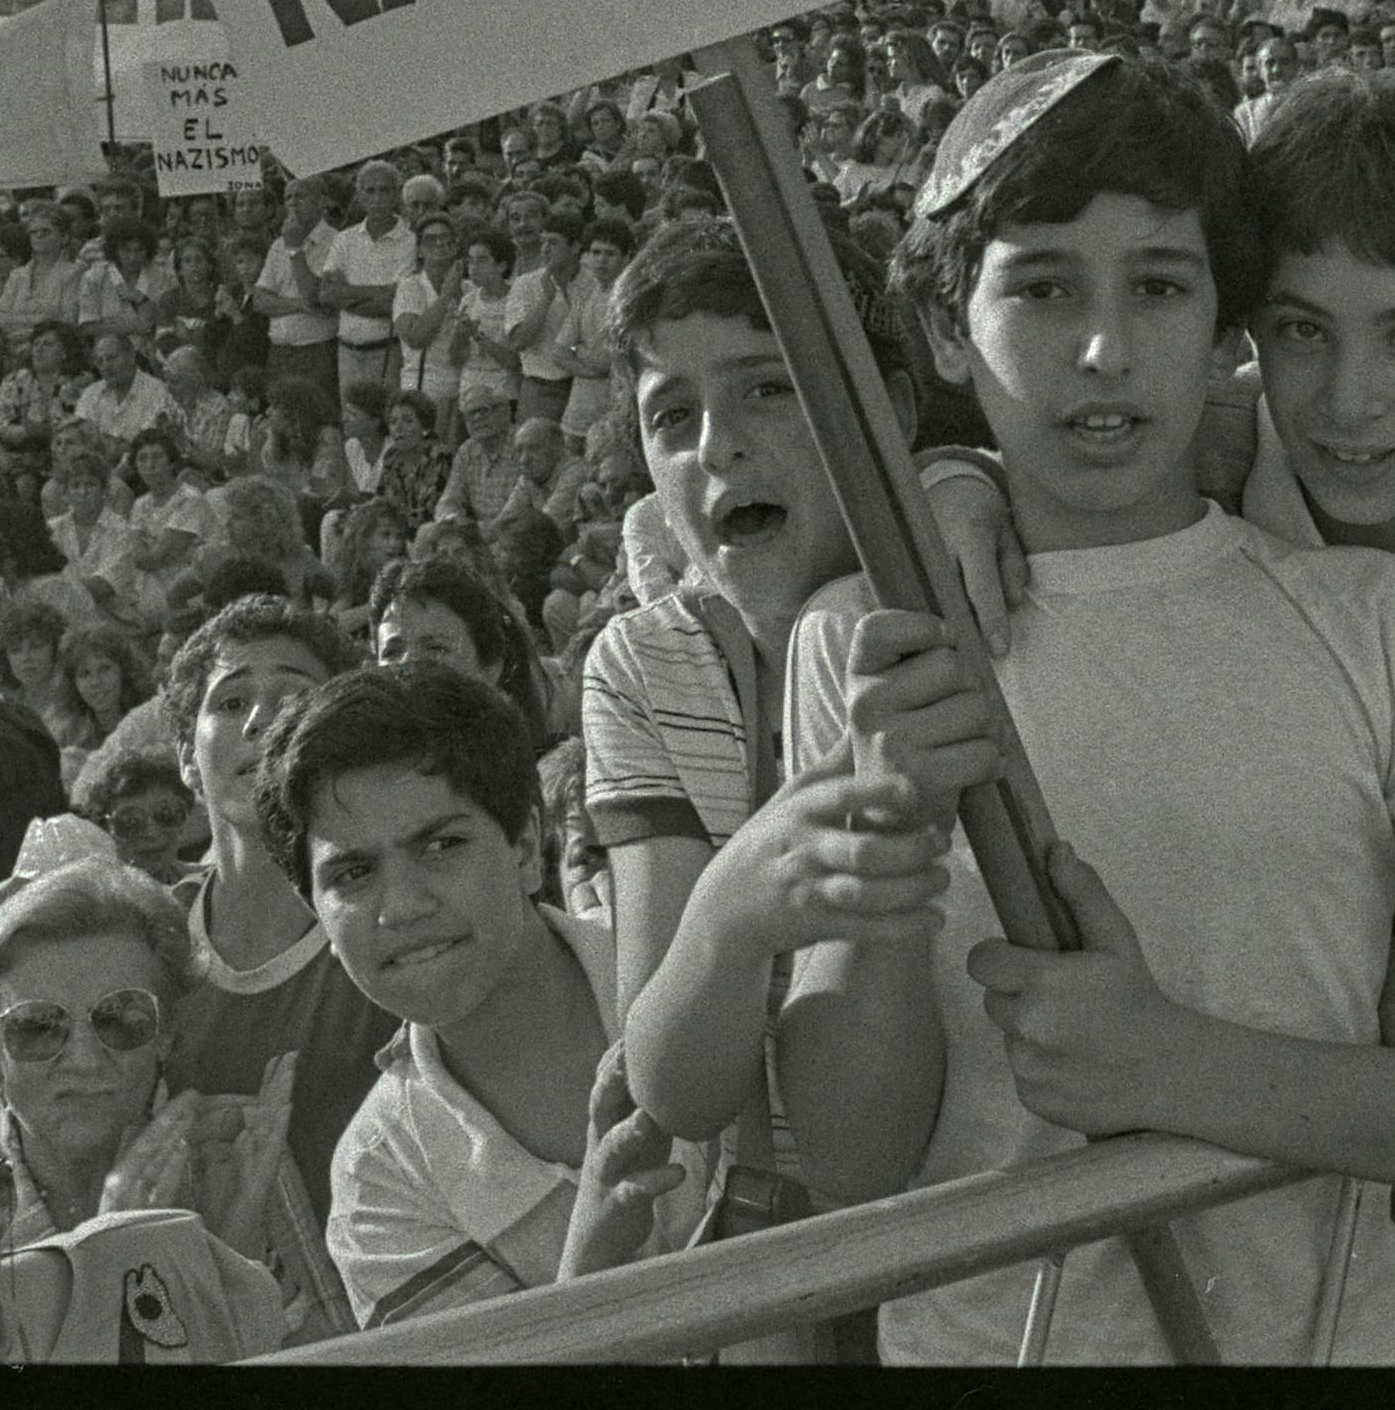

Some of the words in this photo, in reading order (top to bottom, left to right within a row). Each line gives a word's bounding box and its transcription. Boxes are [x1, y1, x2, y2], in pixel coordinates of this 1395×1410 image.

[161, 61, 239, 84] NUNCA
[183, 117, 224, 141] EL
[157, 144, 260, 173] NAZISMO
